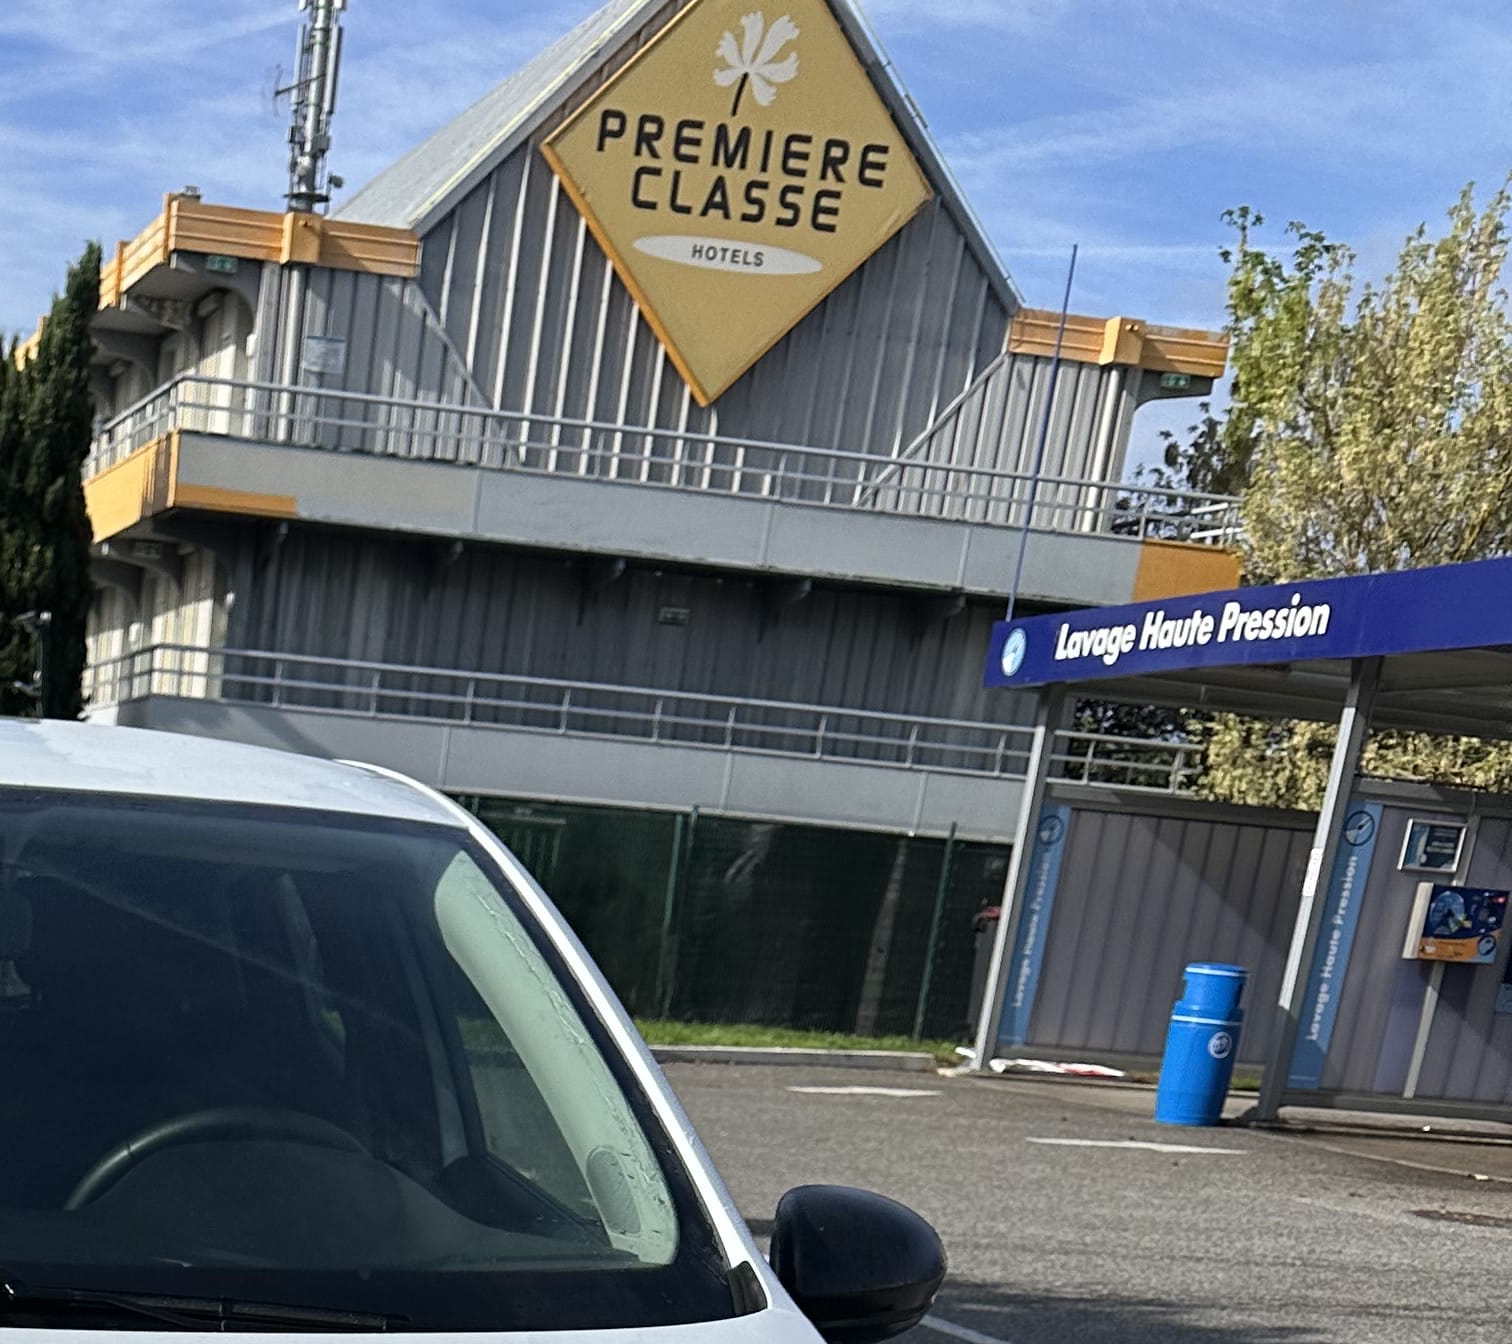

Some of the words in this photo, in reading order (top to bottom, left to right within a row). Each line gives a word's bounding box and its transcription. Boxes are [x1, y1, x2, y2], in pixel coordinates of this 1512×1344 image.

[596, 109, 889, 188] PREMIERE
[631, 166, 842, 233] CLASSE
[691, 244, 764, 267] HOTELS
[1054, 623, 1136, 665] Lavage
[1138, 610, 1214, 650] Haute
[1217, 592, 1330, 642] Pression
[1306, 983, 1330, 1040] Lavage
[1321, 928, 1342, 978] Haute
[1334, 856, 1358, 926] Pression
